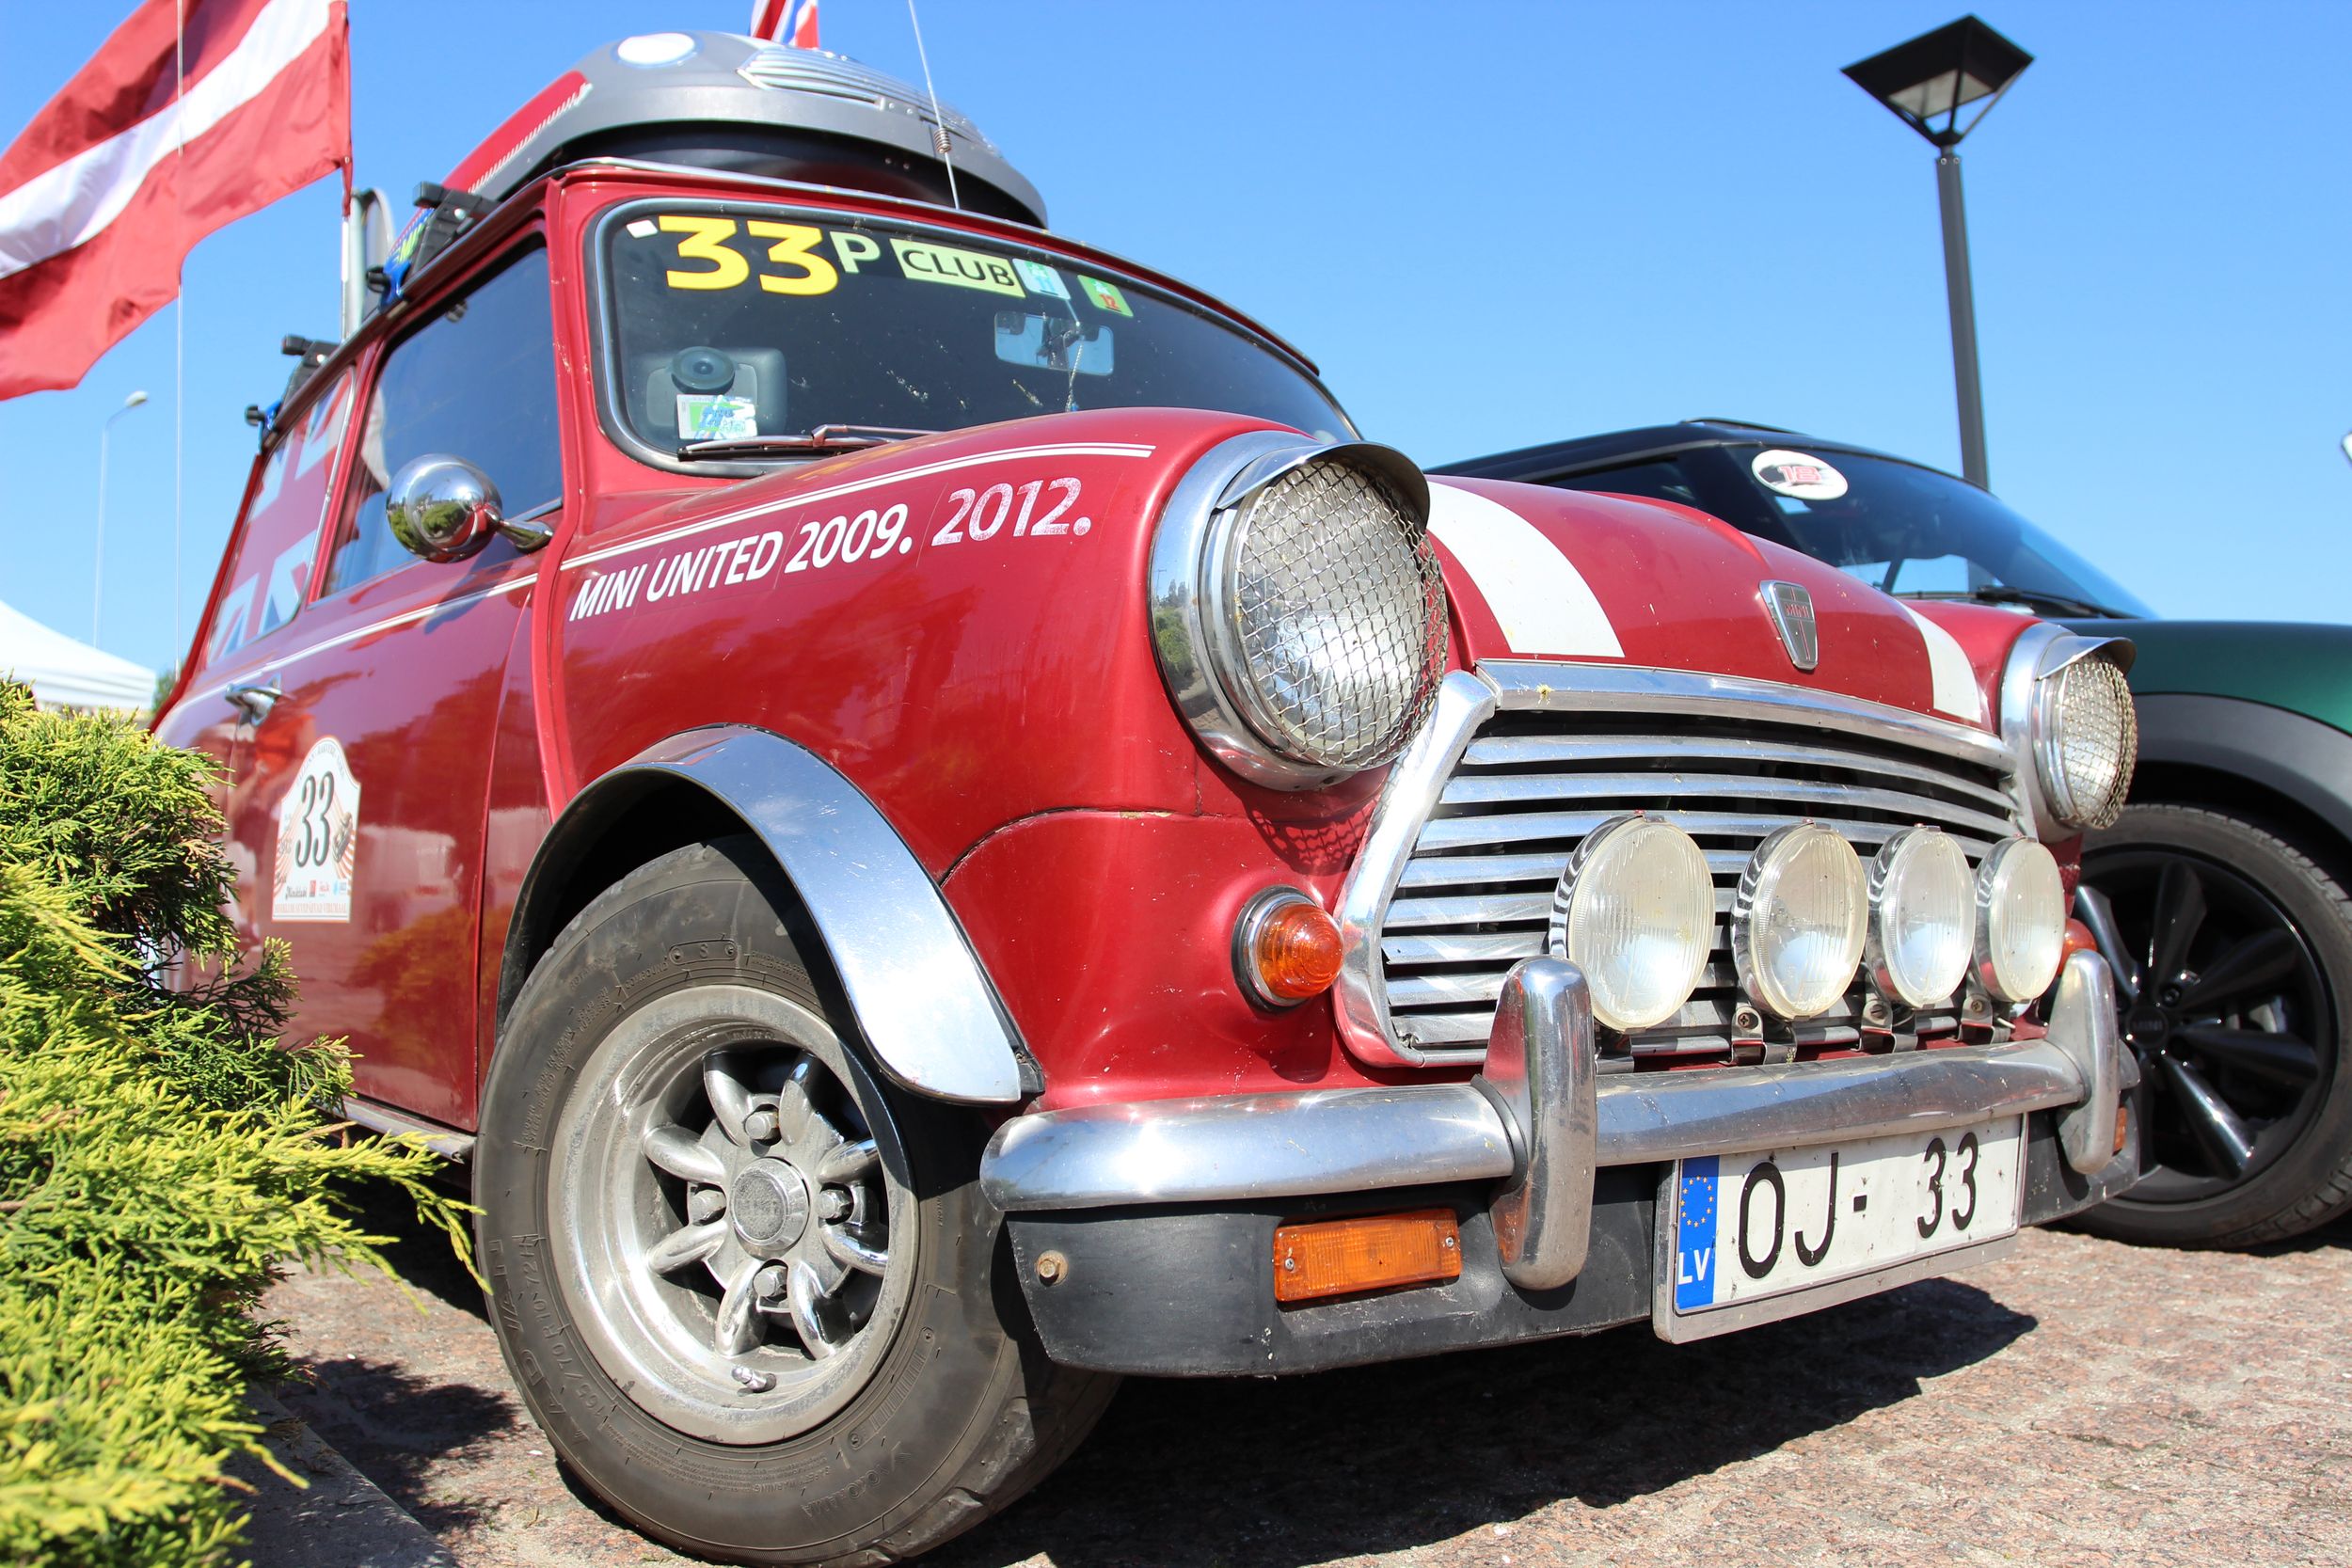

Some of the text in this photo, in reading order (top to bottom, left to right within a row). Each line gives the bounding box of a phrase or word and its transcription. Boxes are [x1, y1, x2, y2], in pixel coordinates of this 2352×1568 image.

[901, 248, 1016, 287] CLUB
[1099, 293, 1120, 309] 12
[569, 477, 1092, 622] MINI UNITED 2009. 2012.
[294, 770, 336, 868] 33
[1677, 1247, 1710, 1286] LV
